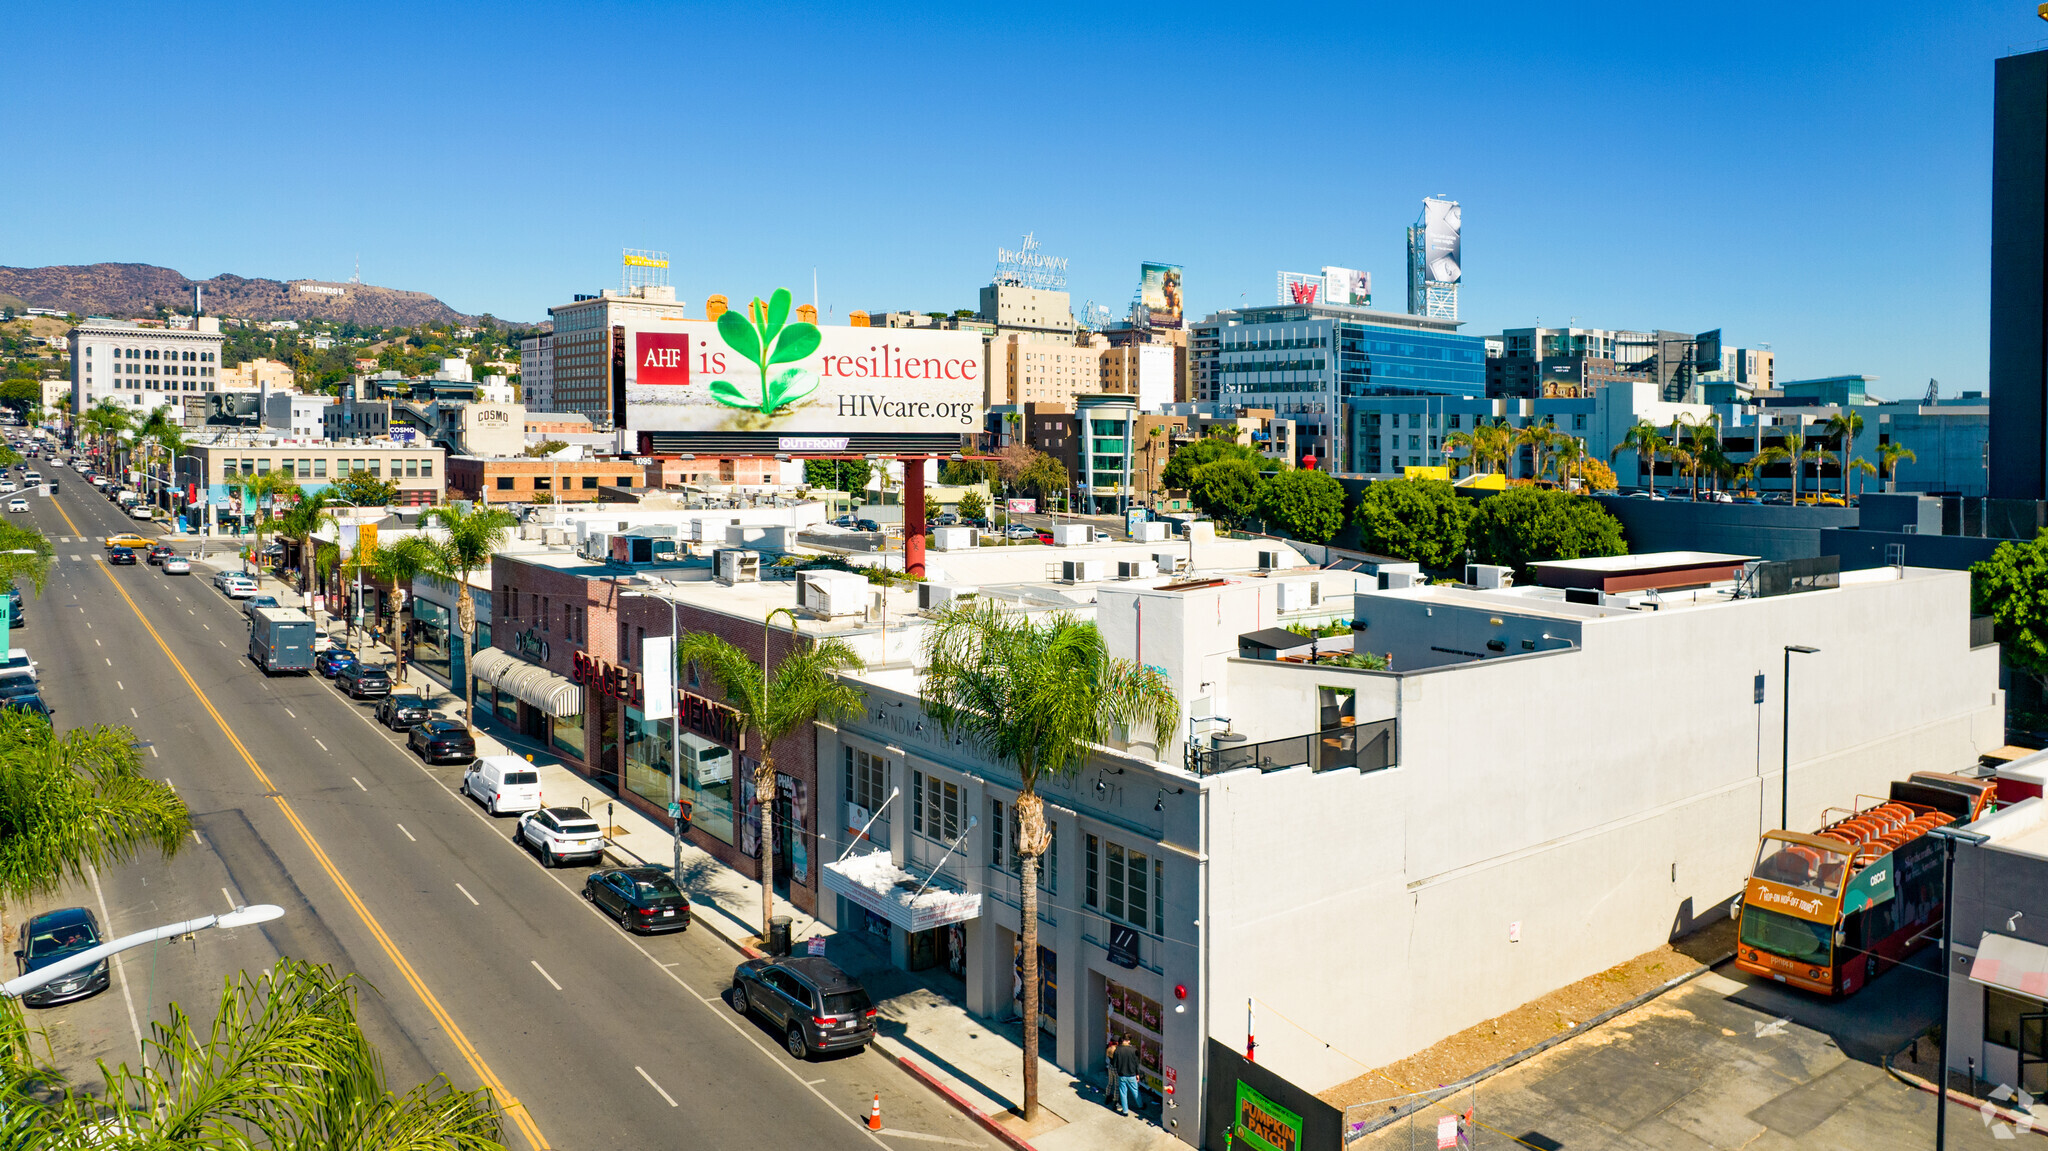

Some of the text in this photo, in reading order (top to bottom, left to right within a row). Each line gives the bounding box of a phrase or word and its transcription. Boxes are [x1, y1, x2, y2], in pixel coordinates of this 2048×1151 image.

[1021, 231, 1041, 258] The
[998, 247, 1068, 270] BROADWAY
[1002, 270, 1066, 286] HOLLYWOOD
[300, 285, 345, 295] HOLLYWOOD
[1289, 281, 1318, 304] W
[644, 348, 680, 367] AHF
[699, 341, 977, 380] is resilience
[477, 410, 509, 423] COSMO
[837, 394, 974, 424] HIVcare.org
[389, 426, 415, 434] COSMO
[781, 439, 845, 448] OUTFRONT
[634, 457, 652, 465] 1095
[572, 649, 628, 701] SPACE
[1763, 892, 1815, 914] HOP-ON HOP-OFF TOURS
[1242, 1098, 1295, 1143] PUMPKIN
[1248, 1116, 1287, 1151] PATCH
